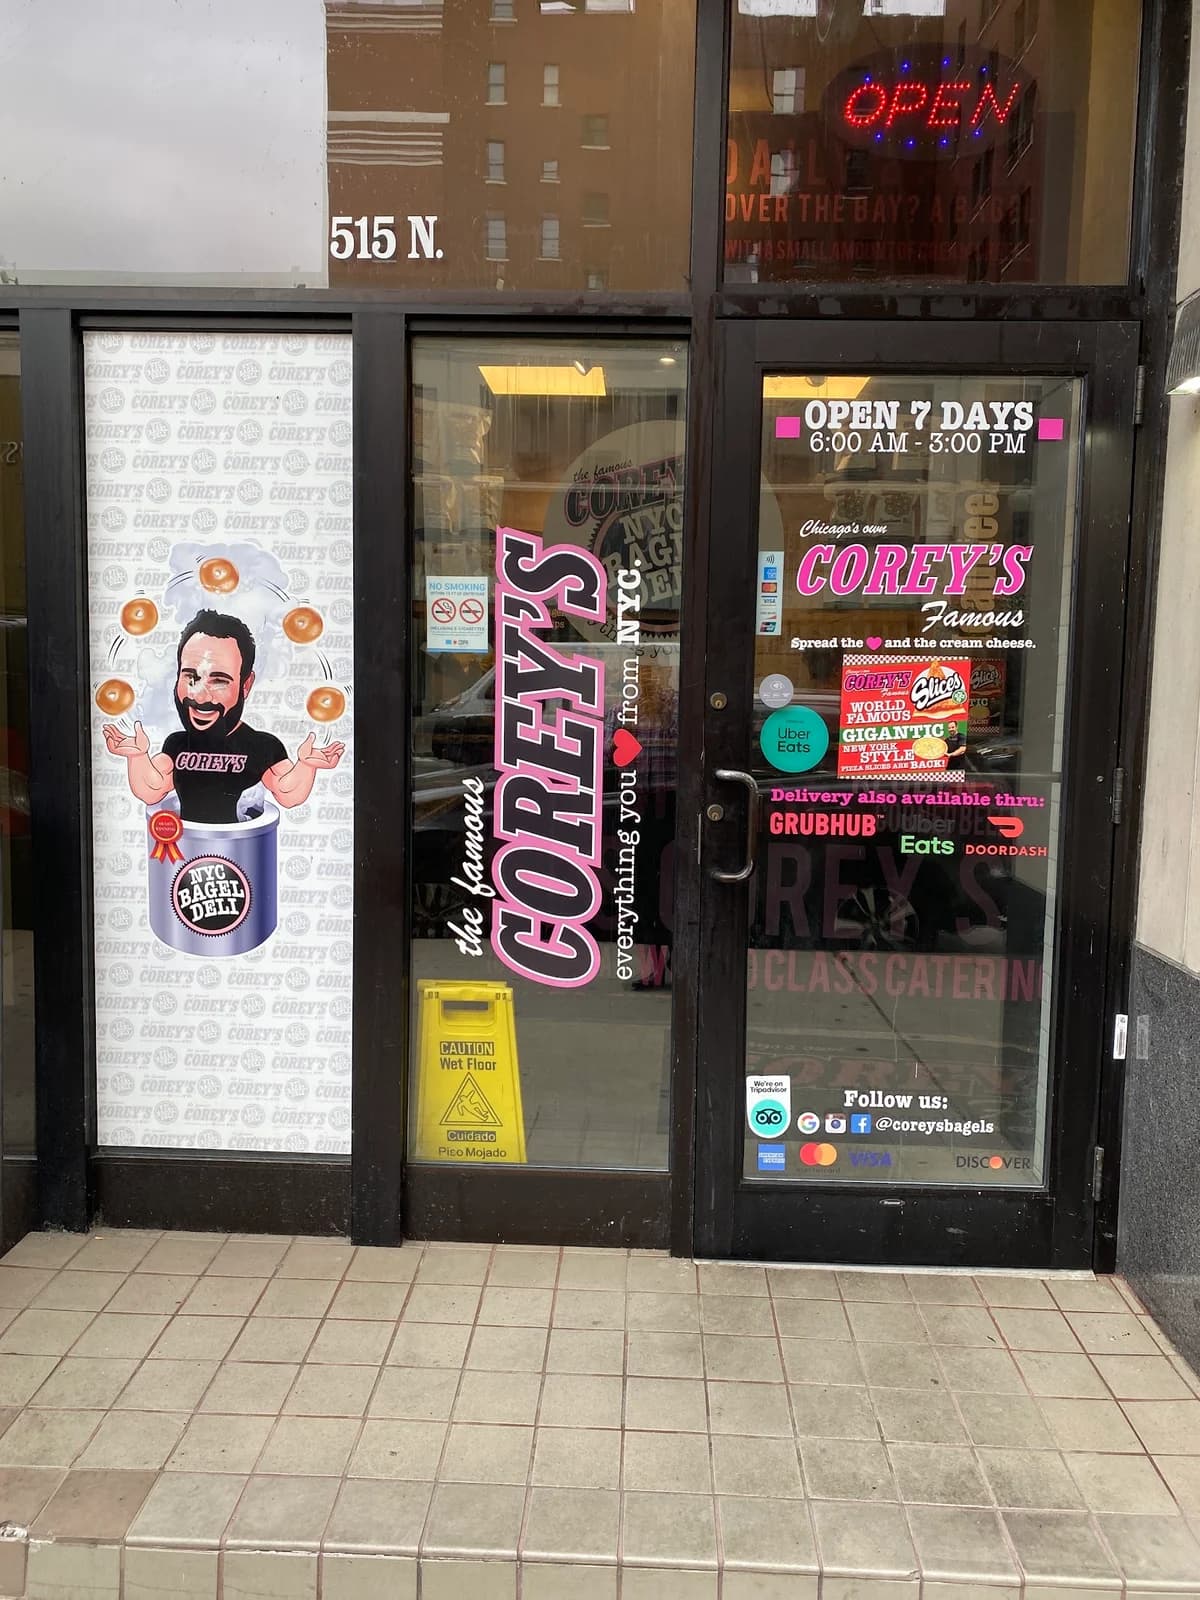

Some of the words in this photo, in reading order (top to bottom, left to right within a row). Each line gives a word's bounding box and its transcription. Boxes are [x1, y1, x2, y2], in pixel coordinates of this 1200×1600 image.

[844, 82, 1021, 128] OPEN
[725, 193, 789, 223] OVER
[799, 193, 844, 223] THE
[329, 215, 397, 260] 515
[407, 215, 444, 259] N.
[804, 400, 900, 430] OPEN
[910, 400, 931, 430] 7
[940, 401, 1034, 431] DAYS
[810, 431, 862, 453] 6:00
[868, 432, 908, 453] AM
[929, 432, 981, 453] 3:00
[988, 433, 1026, 453] PM
[799, 519, 860, 538] Chicago's
[862, 523, 888, 534] own
[797, 543, 1034, 596] COREY'S
[429, 582, 442, 591] NO
[443, 583, 486, 592] SMOKING
[617, 558, 643, 645] NYC.
[921, 601, 1025, 633] Famous
[791, 637, 838, 651] Spread
[840, 637, 864, 648] the
[884, 638, 909, 649] and
[914, 638, 937, 649] the
[939, 639, 983, 649] cream
[986, 638, 1037, 650] cheese.
[617, 658, 639, 725] from
[846, 671, 913, 692] COREY'S
[911, 672, 962, 711] Slices
[850, 699, 906, 714] WORLD
[846, 710, 911, 725] FAMOUS
[778, 728, 811, 740] Uber
[842, 723, 945, 743] GIGANTIC
[490, 524, 608, 989] COREY'S
[777, 741, 811, 753] Eats
[843, 743, 868, 753] NEW
[869, 742, 898, 752] YORK
[860, 749, 915, 764] STYLE
[175, 751, 248, 773] COREY'S
[910, 760, 946, 769] BACK!
[619, 769, 641, 824] you
[771, 788, 854, 807] Delivery
[857, 790, 897, 805] also
[901, 790, 992, 807] available
[995, 793, 1046, 808] thru:
[450, 775, 497, 898] famous
[900, 835, 955, 855] Eats
[965, 844, 1048, 858] DOORDASH
[188, 864, 226, 885] NYC
[178, 880, 245, 909] BAGEL
[613, 827, 641, 981] everything
[190, 897, 240, 923] DELI
[447, 906, 485, 958] the
[440, 1041, 495, 1056] CAUTION
[440, 1058, 463, 1070] Wet
[467, 1058, 497, 1071] Floor
[750, 1087, 787, 1095] Tripadvisor
[753, 1080, 774, 1088] We're
[844, 1090, 912, 1108] Follow
[919, 1095, 949, 1110] us:
[875, 1116, 994, 1135] @coreysbagels
[447, 1130, 497, 1142] Cuidado
[438, 1147, 464, 1157] Piso
[465, 1147, 507, 1160] Mojado
[847, 1149, 893, 1168] VISA
[956, 1155, 1031, 1170] DISCOVER
